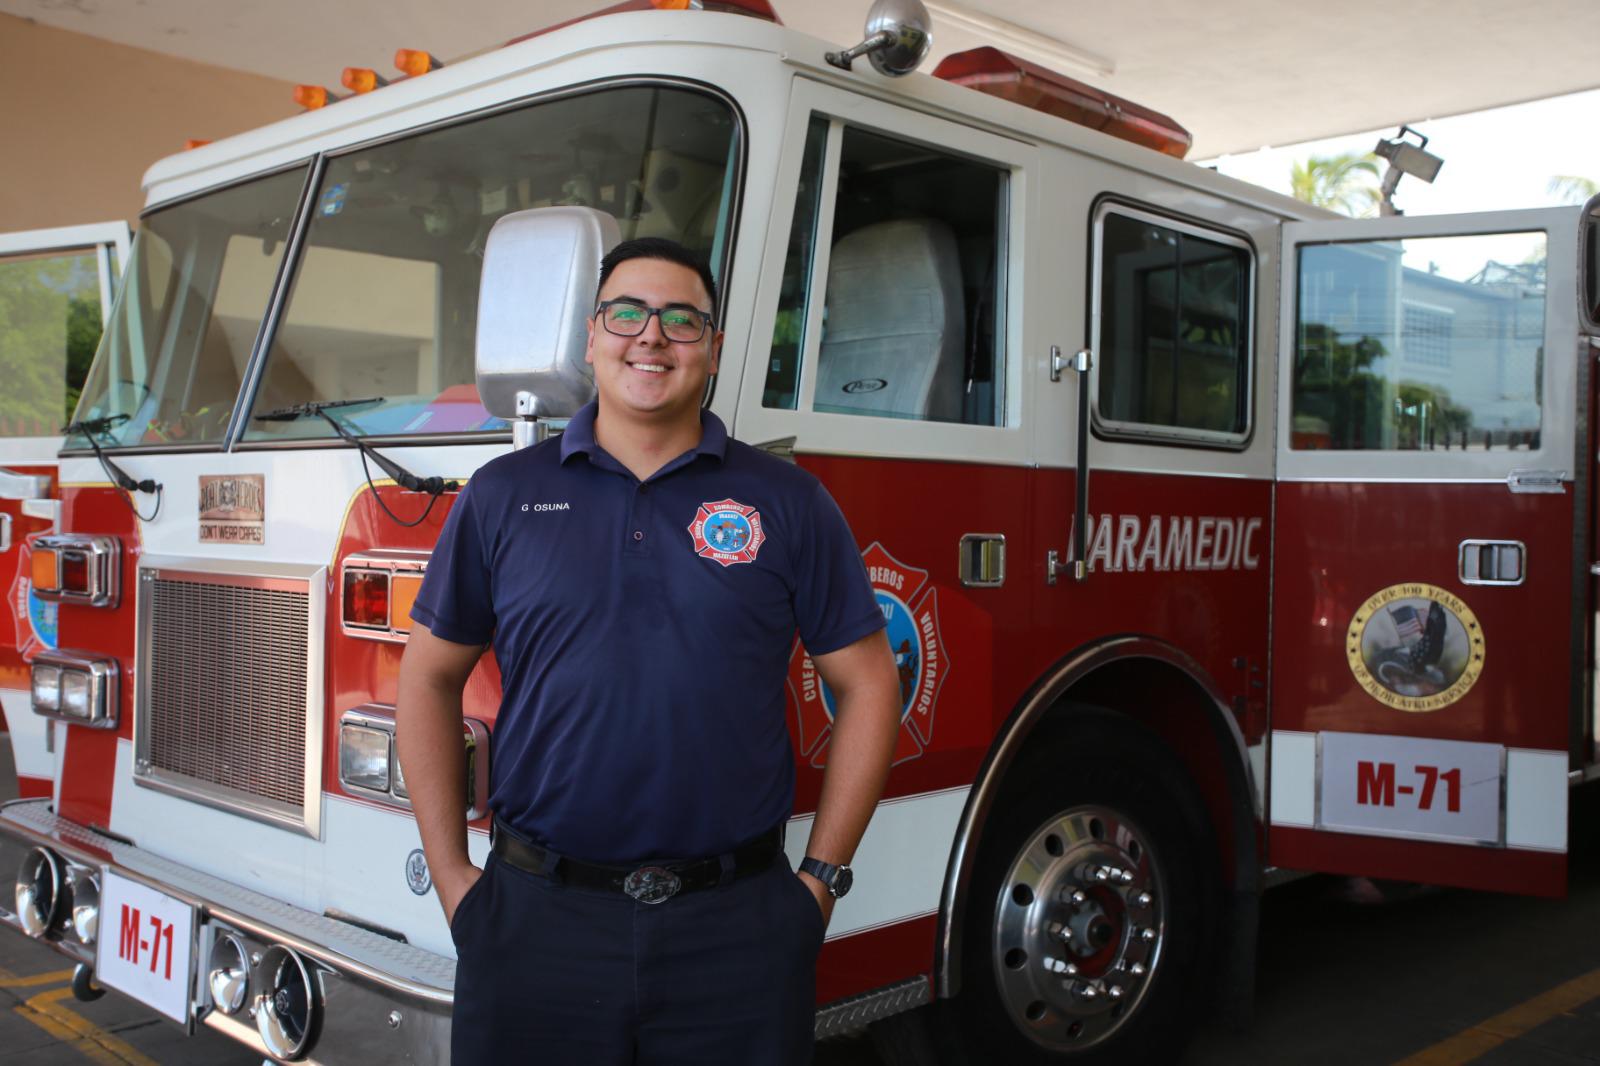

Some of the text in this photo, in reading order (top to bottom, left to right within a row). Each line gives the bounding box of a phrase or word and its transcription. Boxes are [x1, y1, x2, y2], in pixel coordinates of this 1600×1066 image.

[521, 502, 570, 512] G OSUNA
[219, 525, 239, 540] WEAR
[240, 526, 262, 541] CAPES
[1368, 586, 1464, 614] OVER 100 YEARS
[917, 611, 937, 715] VOLUNTARIOS
[1356, 760, 1461, 813] M-71
[119, 903, 174, 981] M-71
